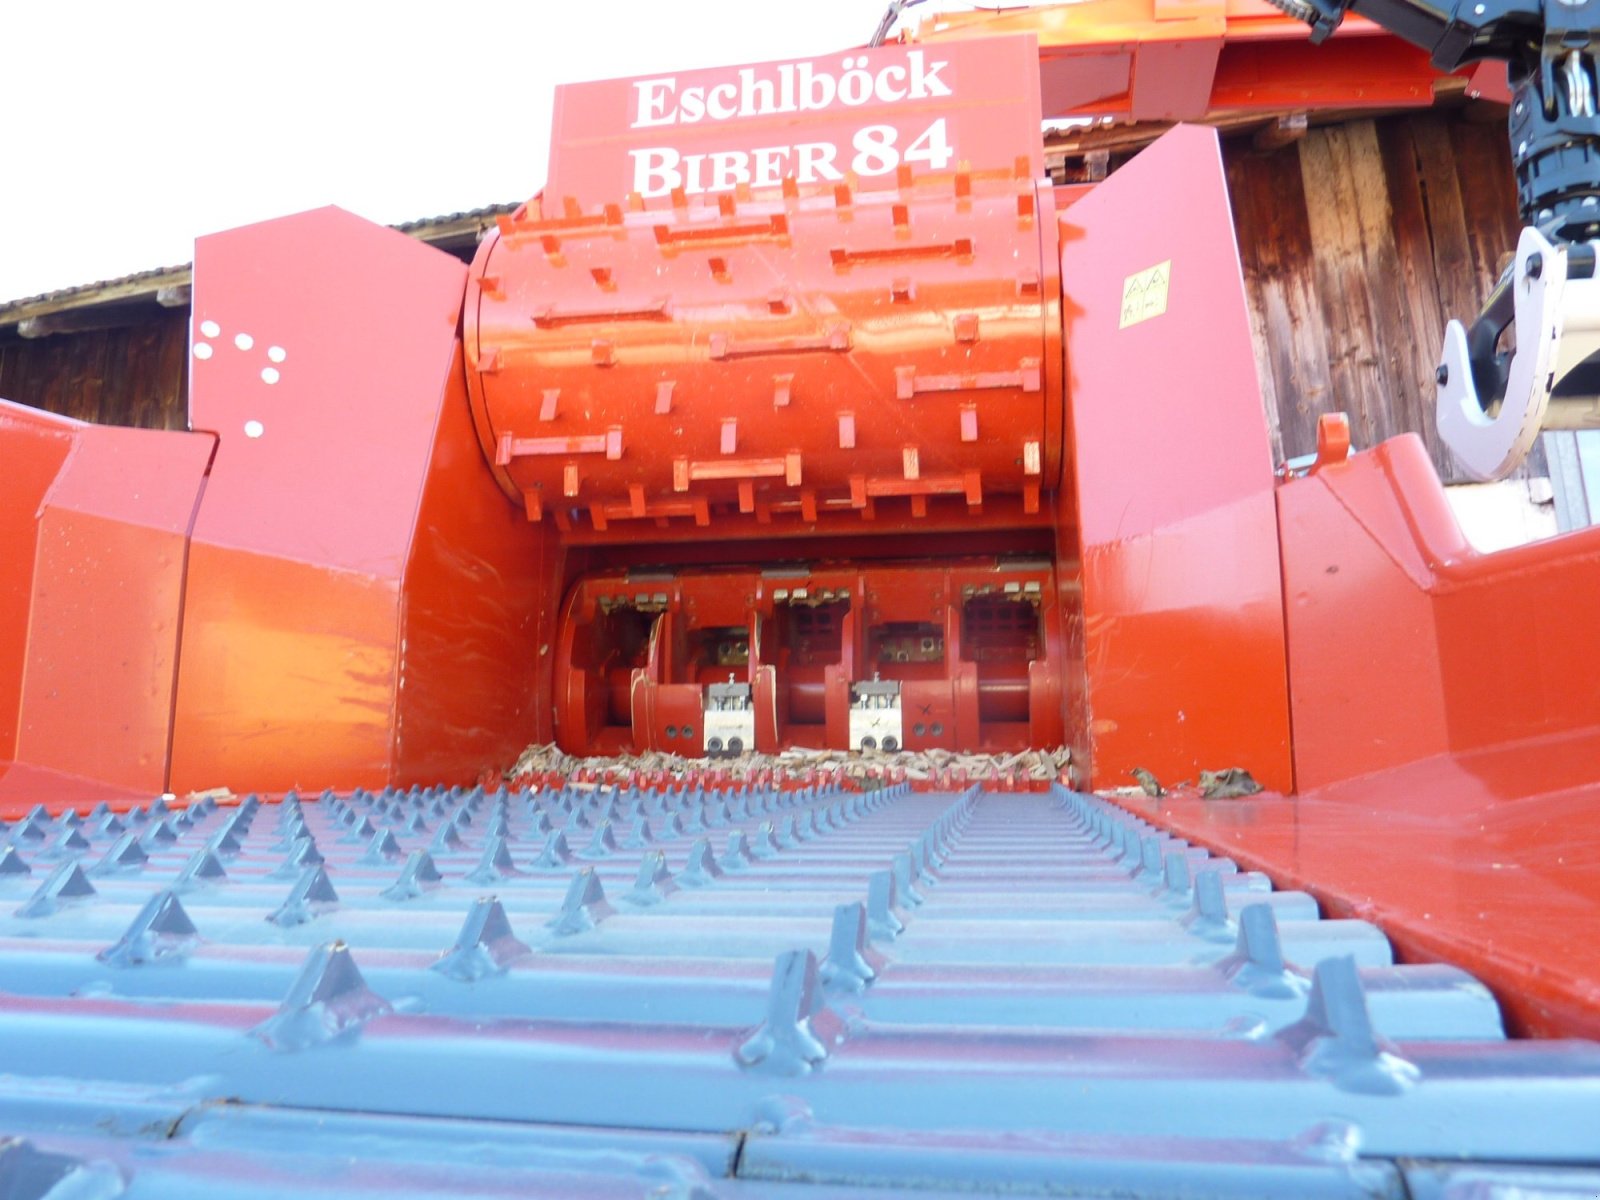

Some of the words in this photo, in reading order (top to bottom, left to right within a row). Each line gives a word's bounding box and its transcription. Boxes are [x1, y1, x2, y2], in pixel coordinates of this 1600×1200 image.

[631, 51, 952, 128] Eschlböck
[628, 142, 843, 199] BIBER
[852, 118, 953, 176] 84
